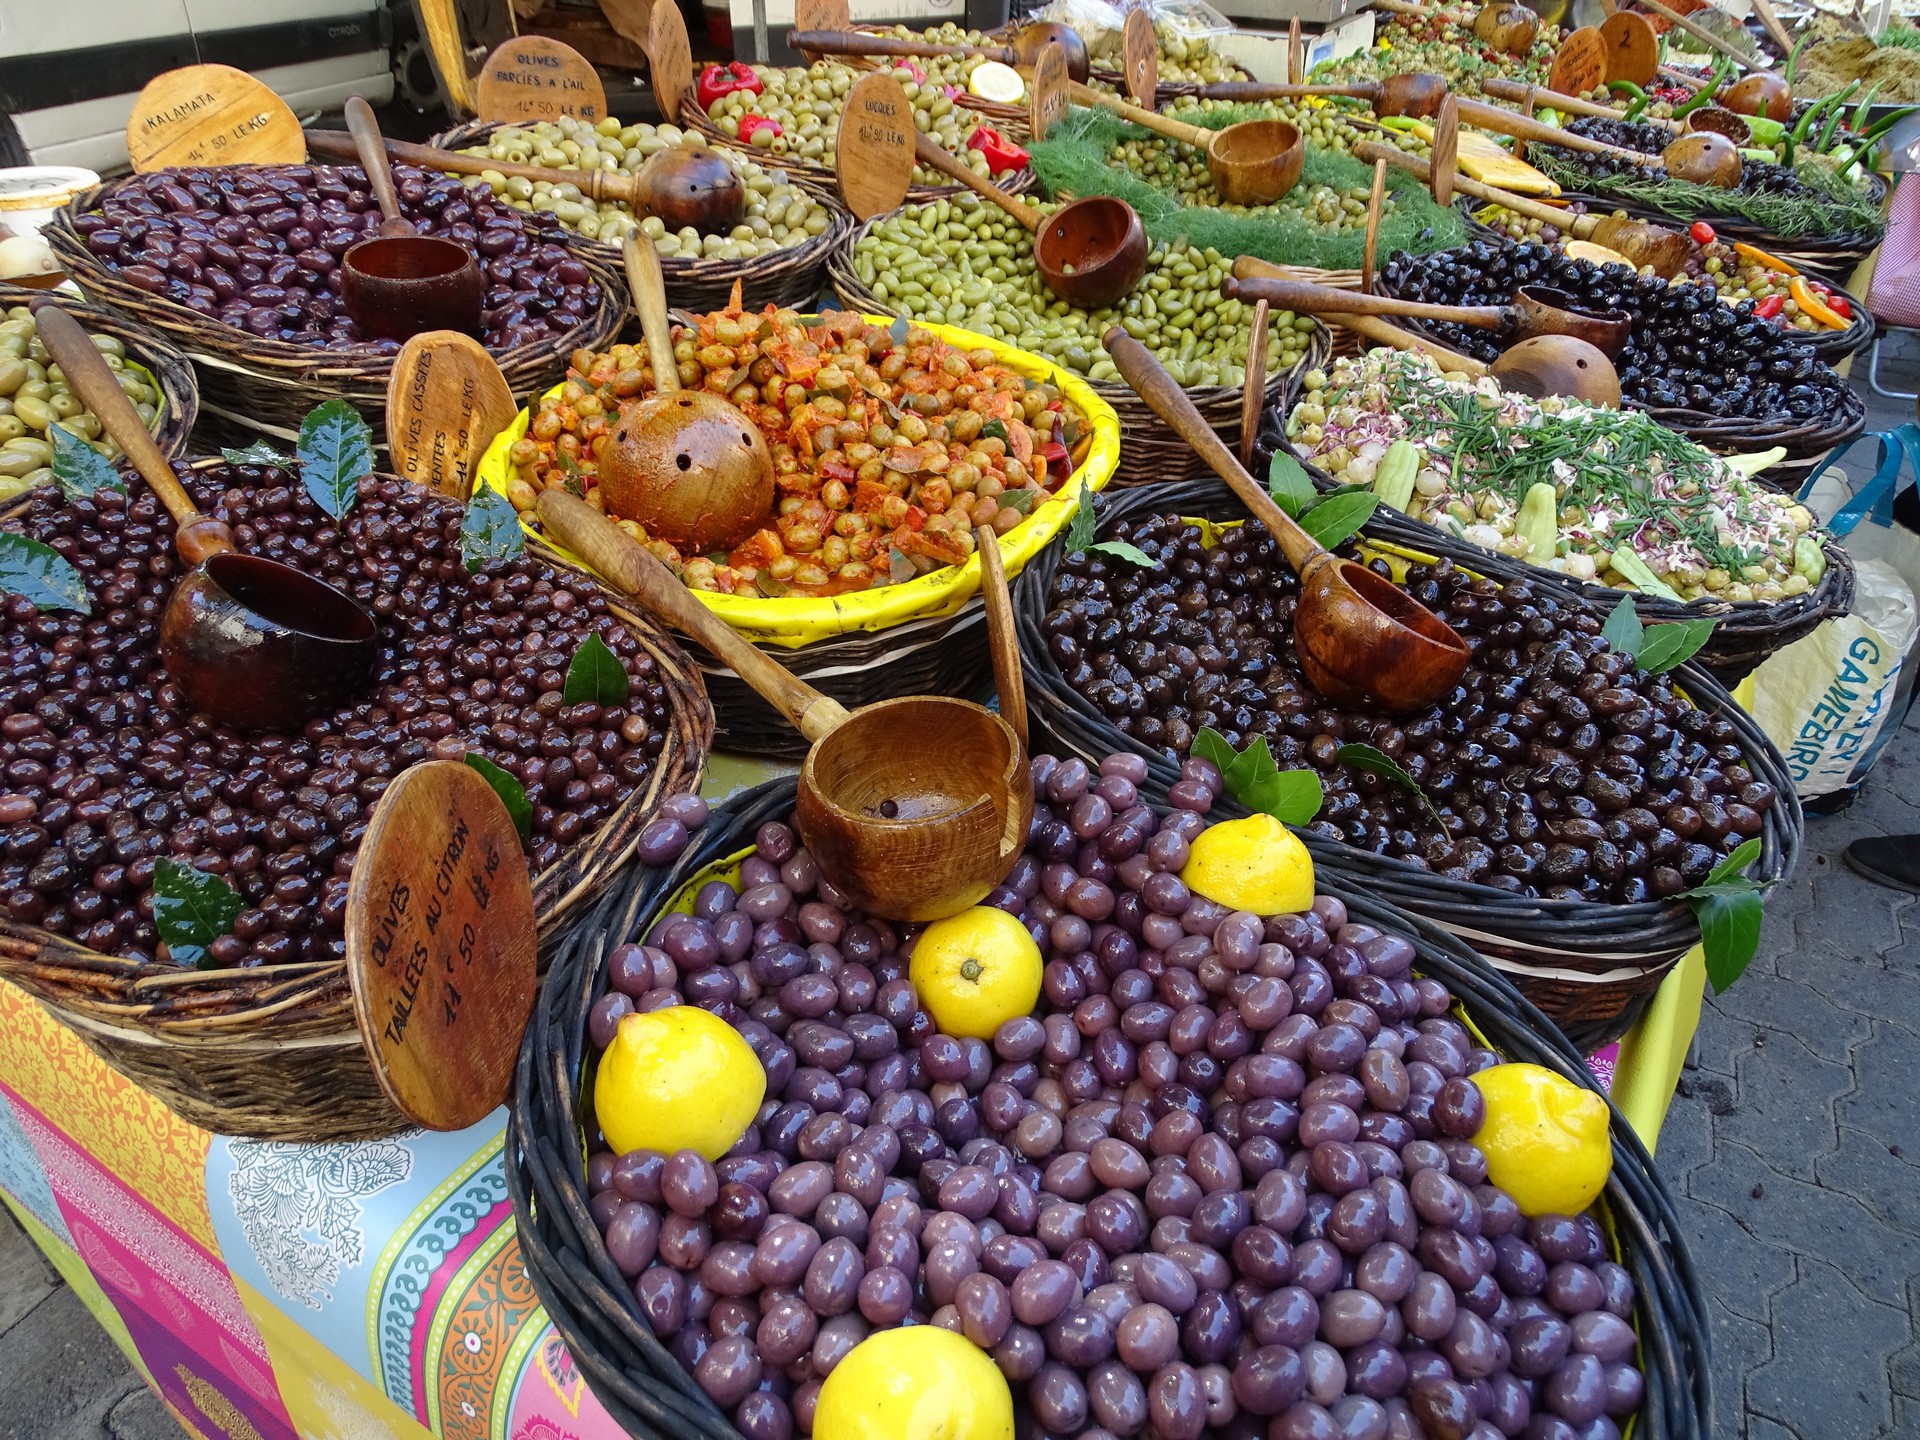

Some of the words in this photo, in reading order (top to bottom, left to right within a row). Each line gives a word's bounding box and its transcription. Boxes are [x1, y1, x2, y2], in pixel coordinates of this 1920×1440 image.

[1619, 29, 1631, 48] 2
[517, 54, 560, 67] OLIVES
[146, 92, 216, 129] KALAMATA
[538, 102, 554, 114] 50
[561, 104, 574, 115] LE
[211, 134, 228, 150] 50
[232, 123, 249, 140] LE
[404, 417, 422, 472] OLIVES
[458, 429, 469, 451] 50
[457, 922, 476, 967] 50
[482, 845, 501, 882] KG
[371, 878, 411, 968] OLIVES
[384, 940, 428, 1047] TAILLEES
[425, 894, 443, 936] AU
[435, 817, 470, 898] CITRON
